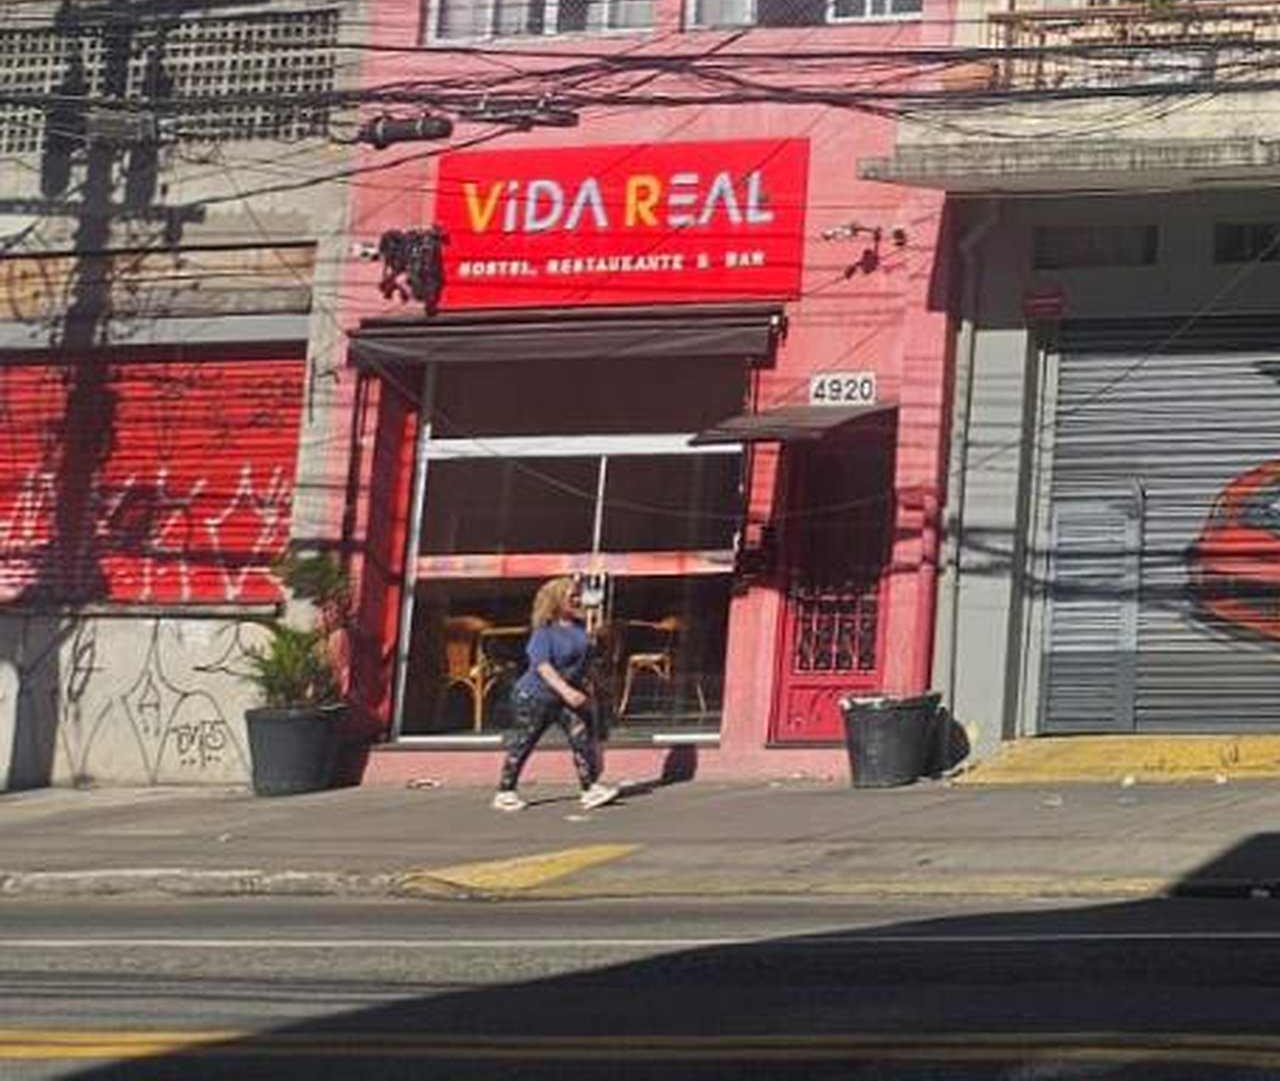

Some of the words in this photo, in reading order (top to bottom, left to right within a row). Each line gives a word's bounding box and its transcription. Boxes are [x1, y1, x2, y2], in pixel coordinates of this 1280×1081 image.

[624, 170, 775, 227] REAL
[546, 253, 683, 275] RESTAURANTE
[725, 250, 766, 268] BAR
[813, 379, 873, 400] 4920
